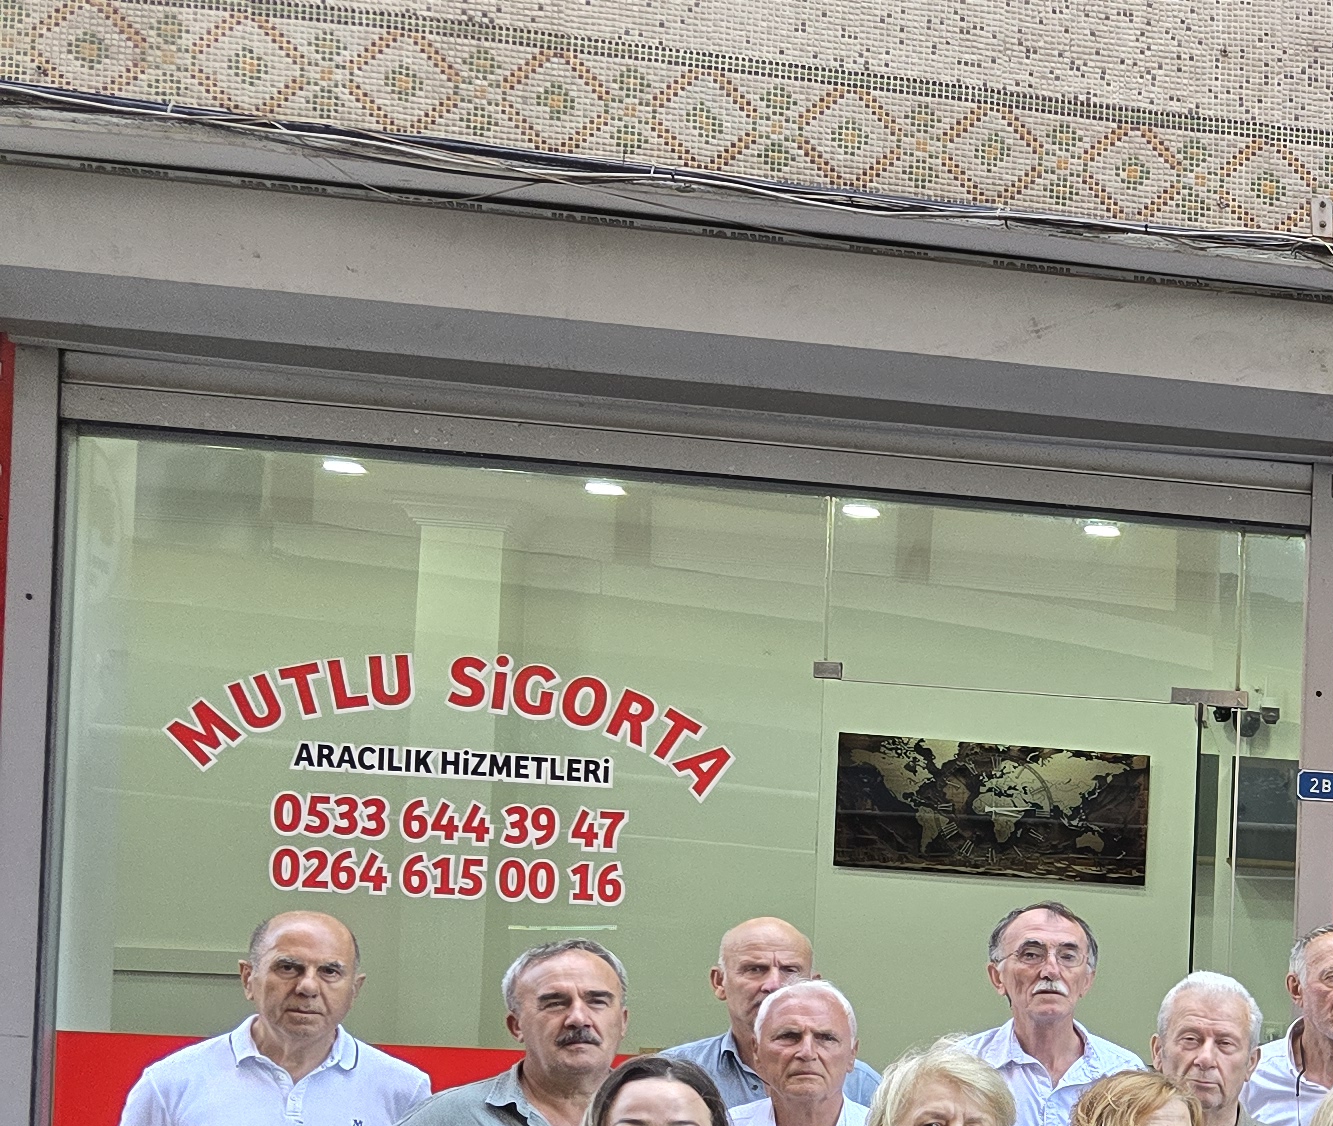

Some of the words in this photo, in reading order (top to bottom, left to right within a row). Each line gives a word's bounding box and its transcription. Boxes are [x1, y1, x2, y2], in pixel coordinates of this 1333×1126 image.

[165, 653, 413, 768] MUTLU
[293, 742, 433, 775] ARACILIK
[1310, 777, 1332, 794] 2B
[273, 793, 387, 837] 0533
[402, 799, 491, 844] 644
[503, 805, 558, 846] 39
[570, 808, 626, 849] 47
[272, 848, 388, 892] 0264
[402, 854, 484, 897] 615
[499, 859, 556, 900] 00
[569, 862, 623, 903] 16
